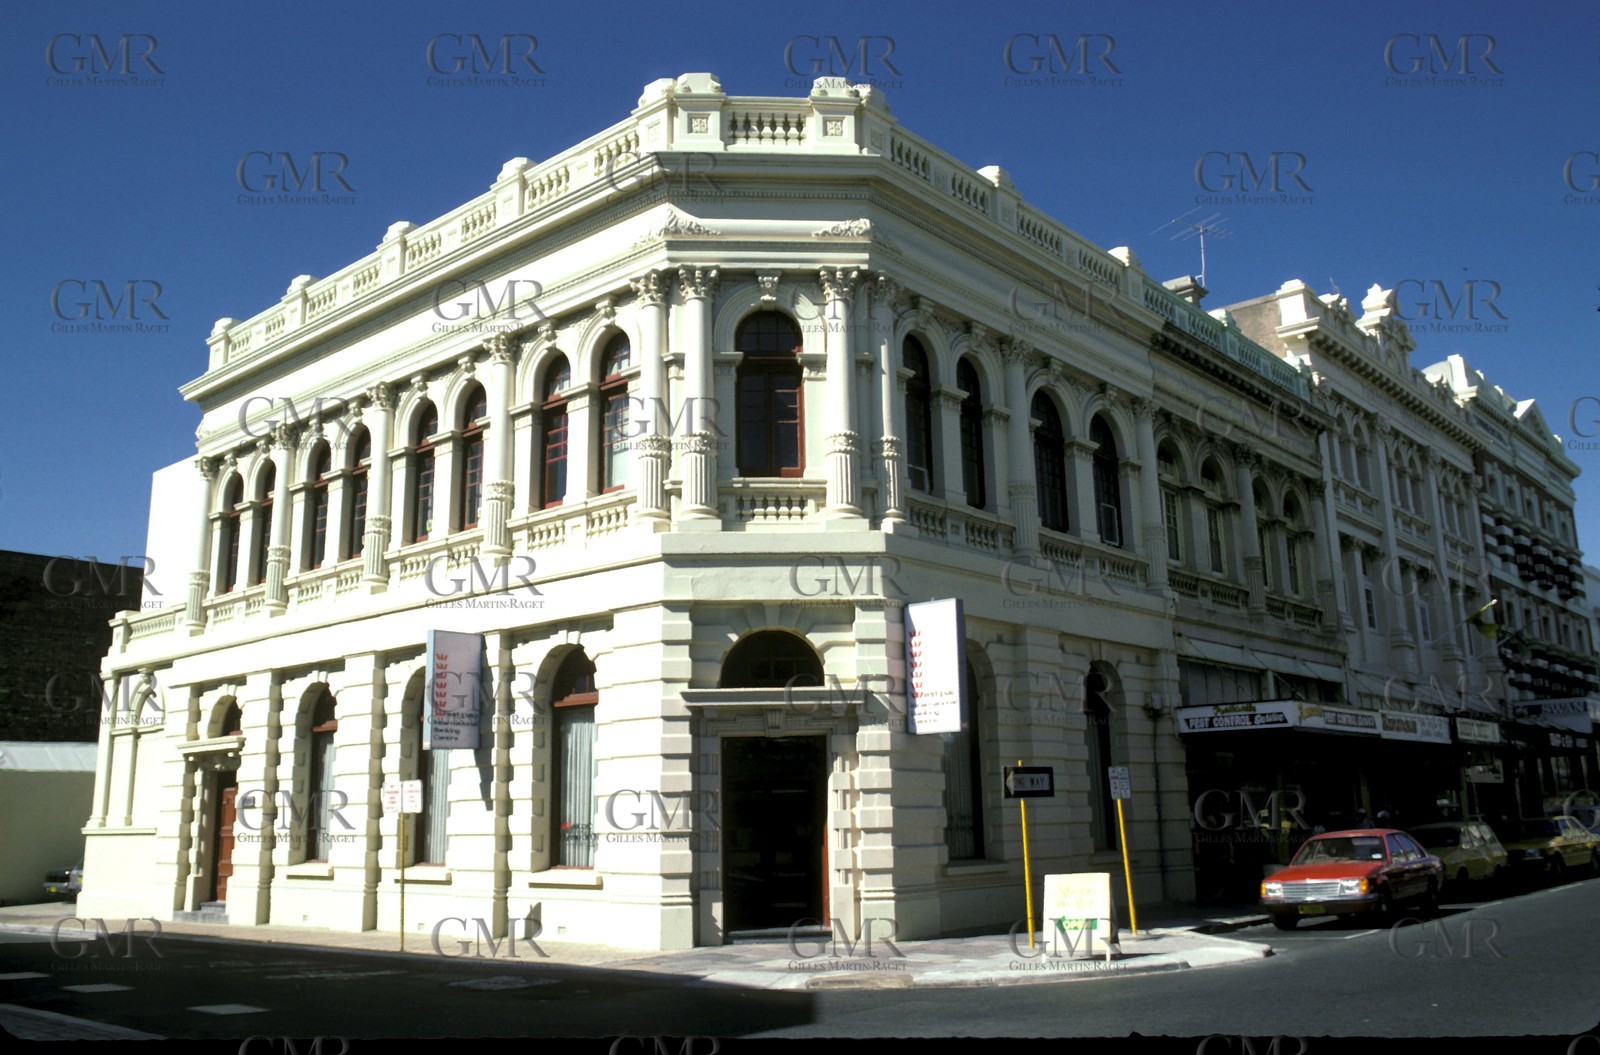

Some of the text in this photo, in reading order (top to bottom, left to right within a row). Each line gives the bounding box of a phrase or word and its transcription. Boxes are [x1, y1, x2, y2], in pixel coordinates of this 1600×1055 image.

[1541, 701, 1584, 714] SWAN
[1189, 718, 1210, 729] PEST
[1212, 715, 1253, 727] CONTROL
[1030, 776, 1044, 788] WAY
